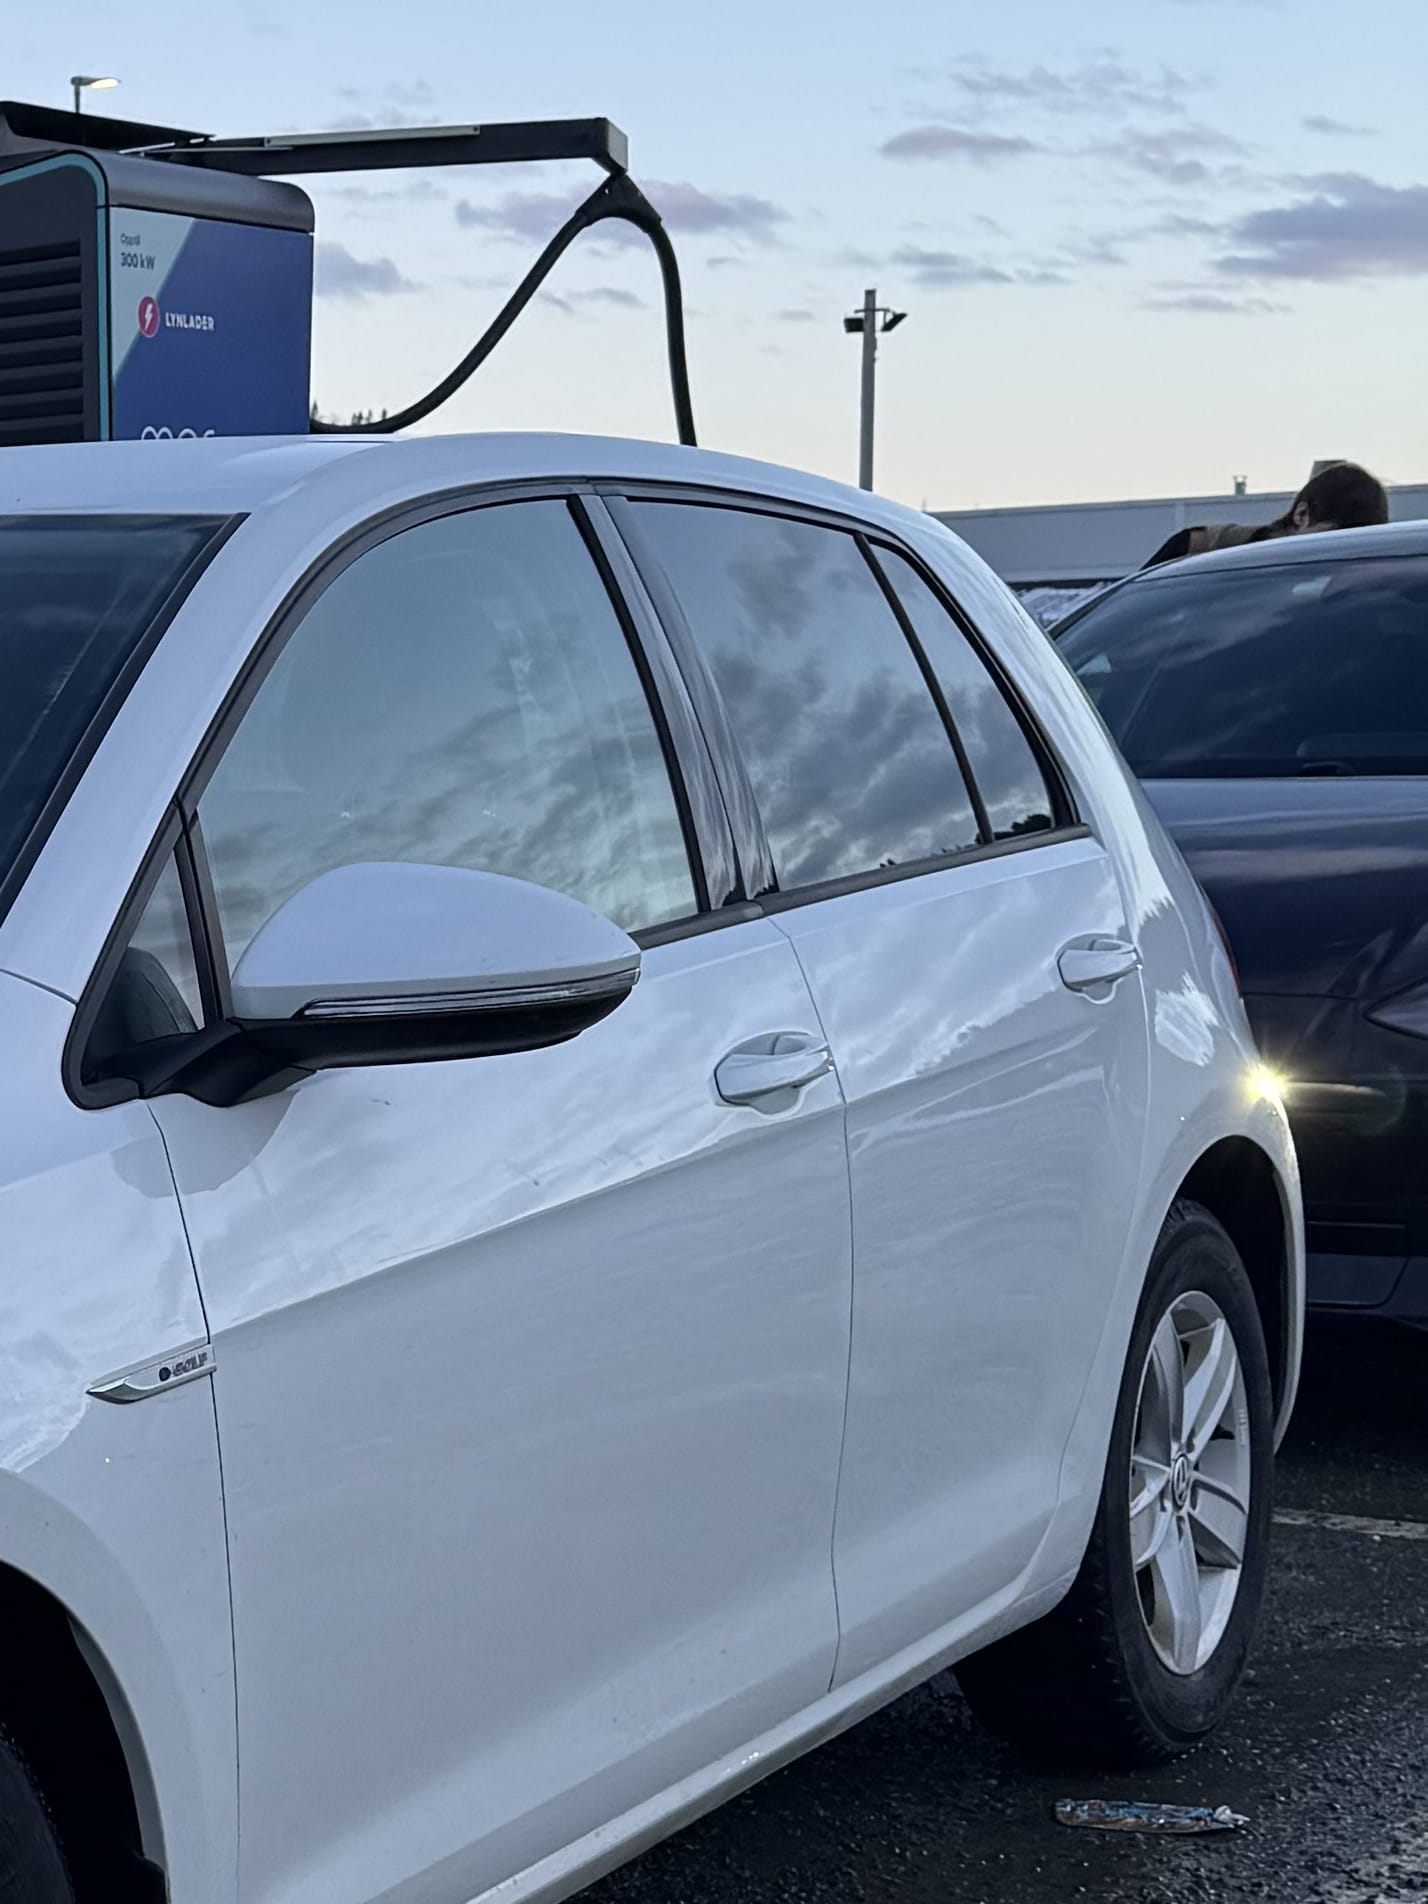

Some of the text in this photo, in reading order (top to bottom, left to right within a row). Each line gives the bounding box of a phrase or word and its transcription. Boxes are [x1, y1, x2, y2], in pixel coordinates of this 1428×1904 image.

[120, 252, 155, 270] 300 kW
[165, 312, 214, 330] LYNLADER
